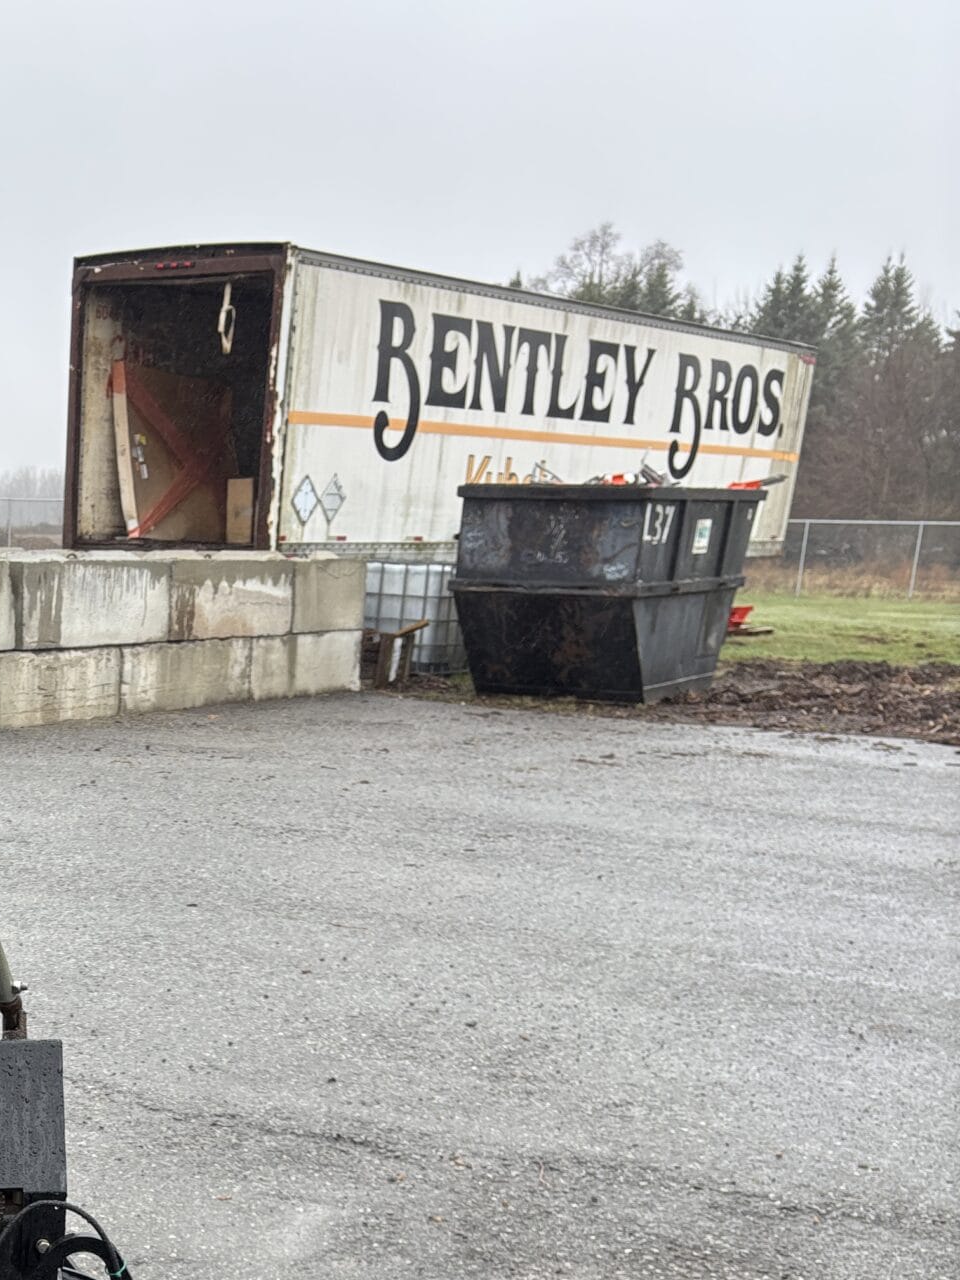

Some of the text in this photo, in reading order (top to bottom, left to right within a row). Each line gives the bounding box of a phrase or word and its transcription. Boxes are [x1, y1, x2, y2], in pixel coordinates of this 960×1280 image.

[372, 299, 786, 480] BENTLEY BROS.
[642, 502, 676, 545] L37
